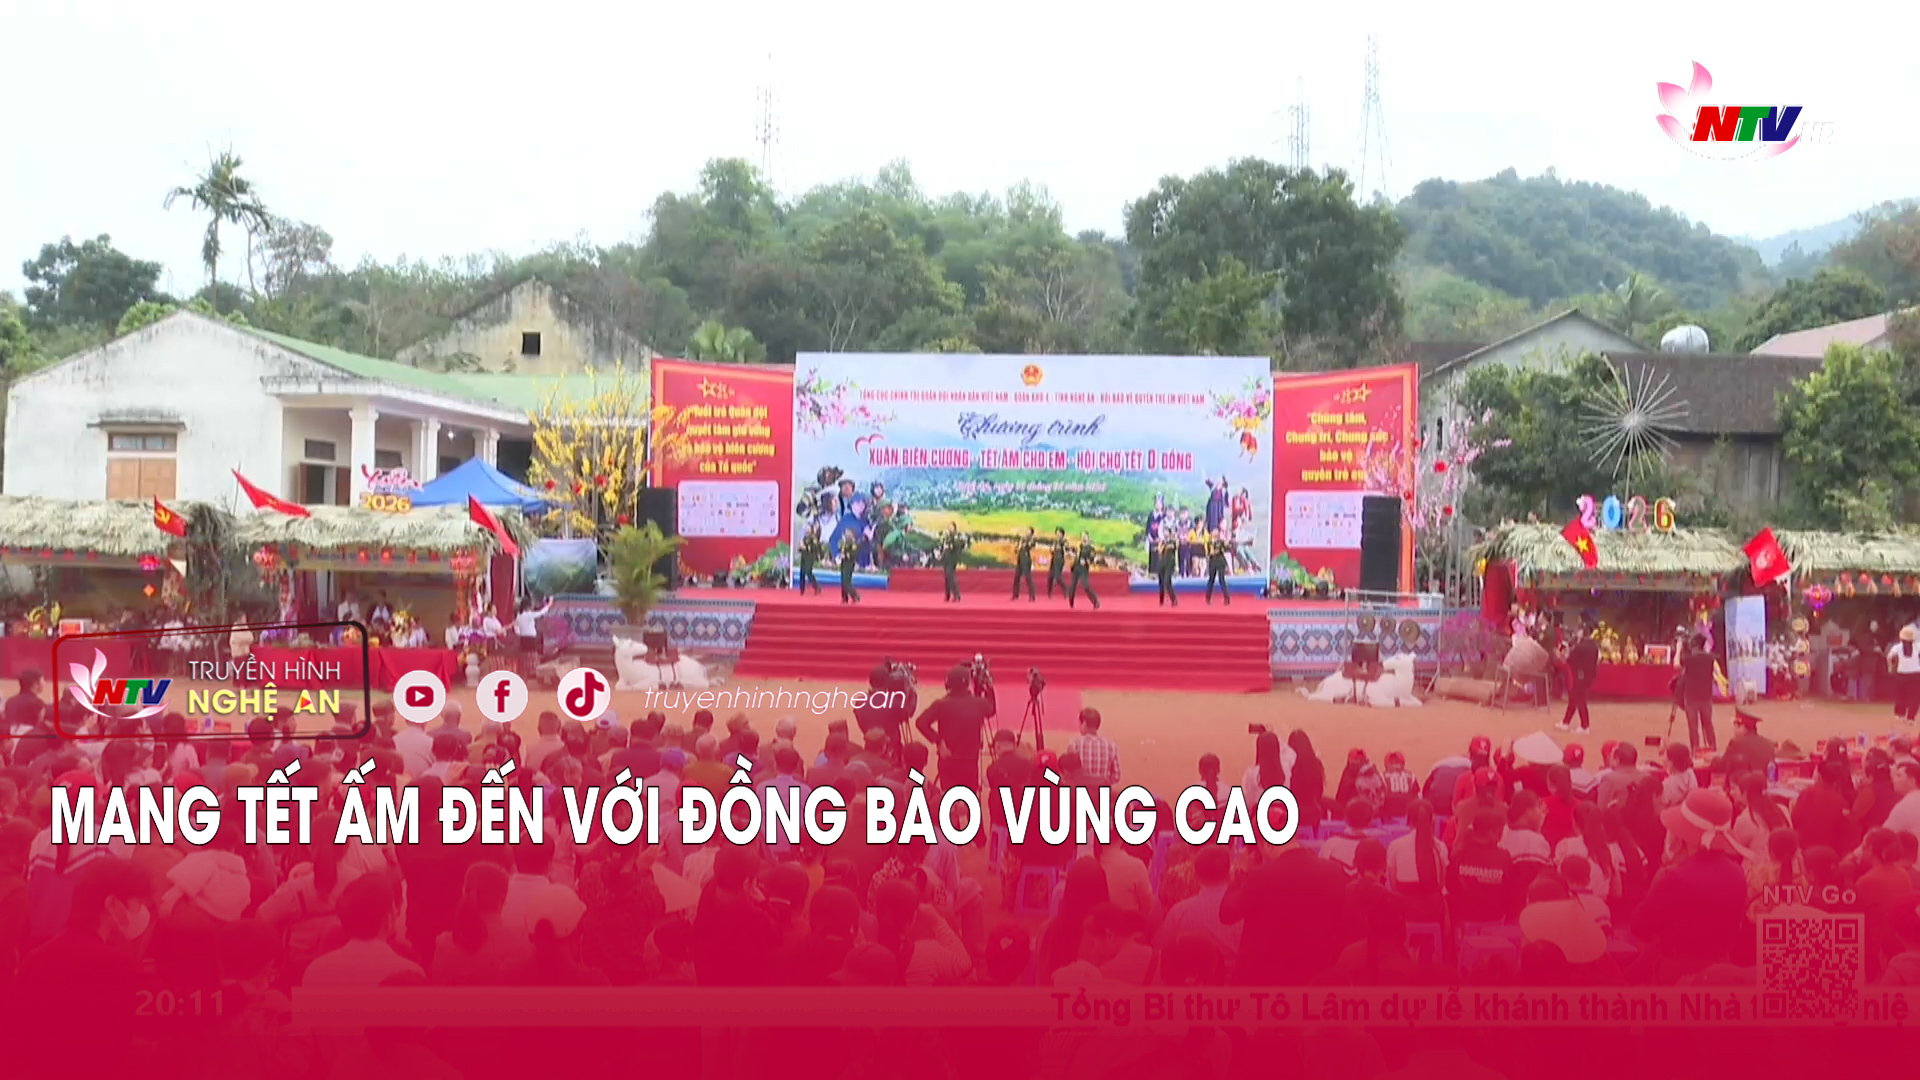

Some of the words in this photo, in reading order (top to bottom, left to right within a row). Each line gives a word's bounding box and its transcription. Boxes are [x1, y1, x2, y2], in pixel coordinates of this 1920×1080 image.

[869, 446, 899, 467] XUÂN
[902, 447, 928, 467] BIÊN
[931, 447, 970, 468] CƯƠNG
[1049, 449, 1066, 470] EM
[360, 494, 411, 512] 2026
[1576, 494, 1676, 533] 2026
